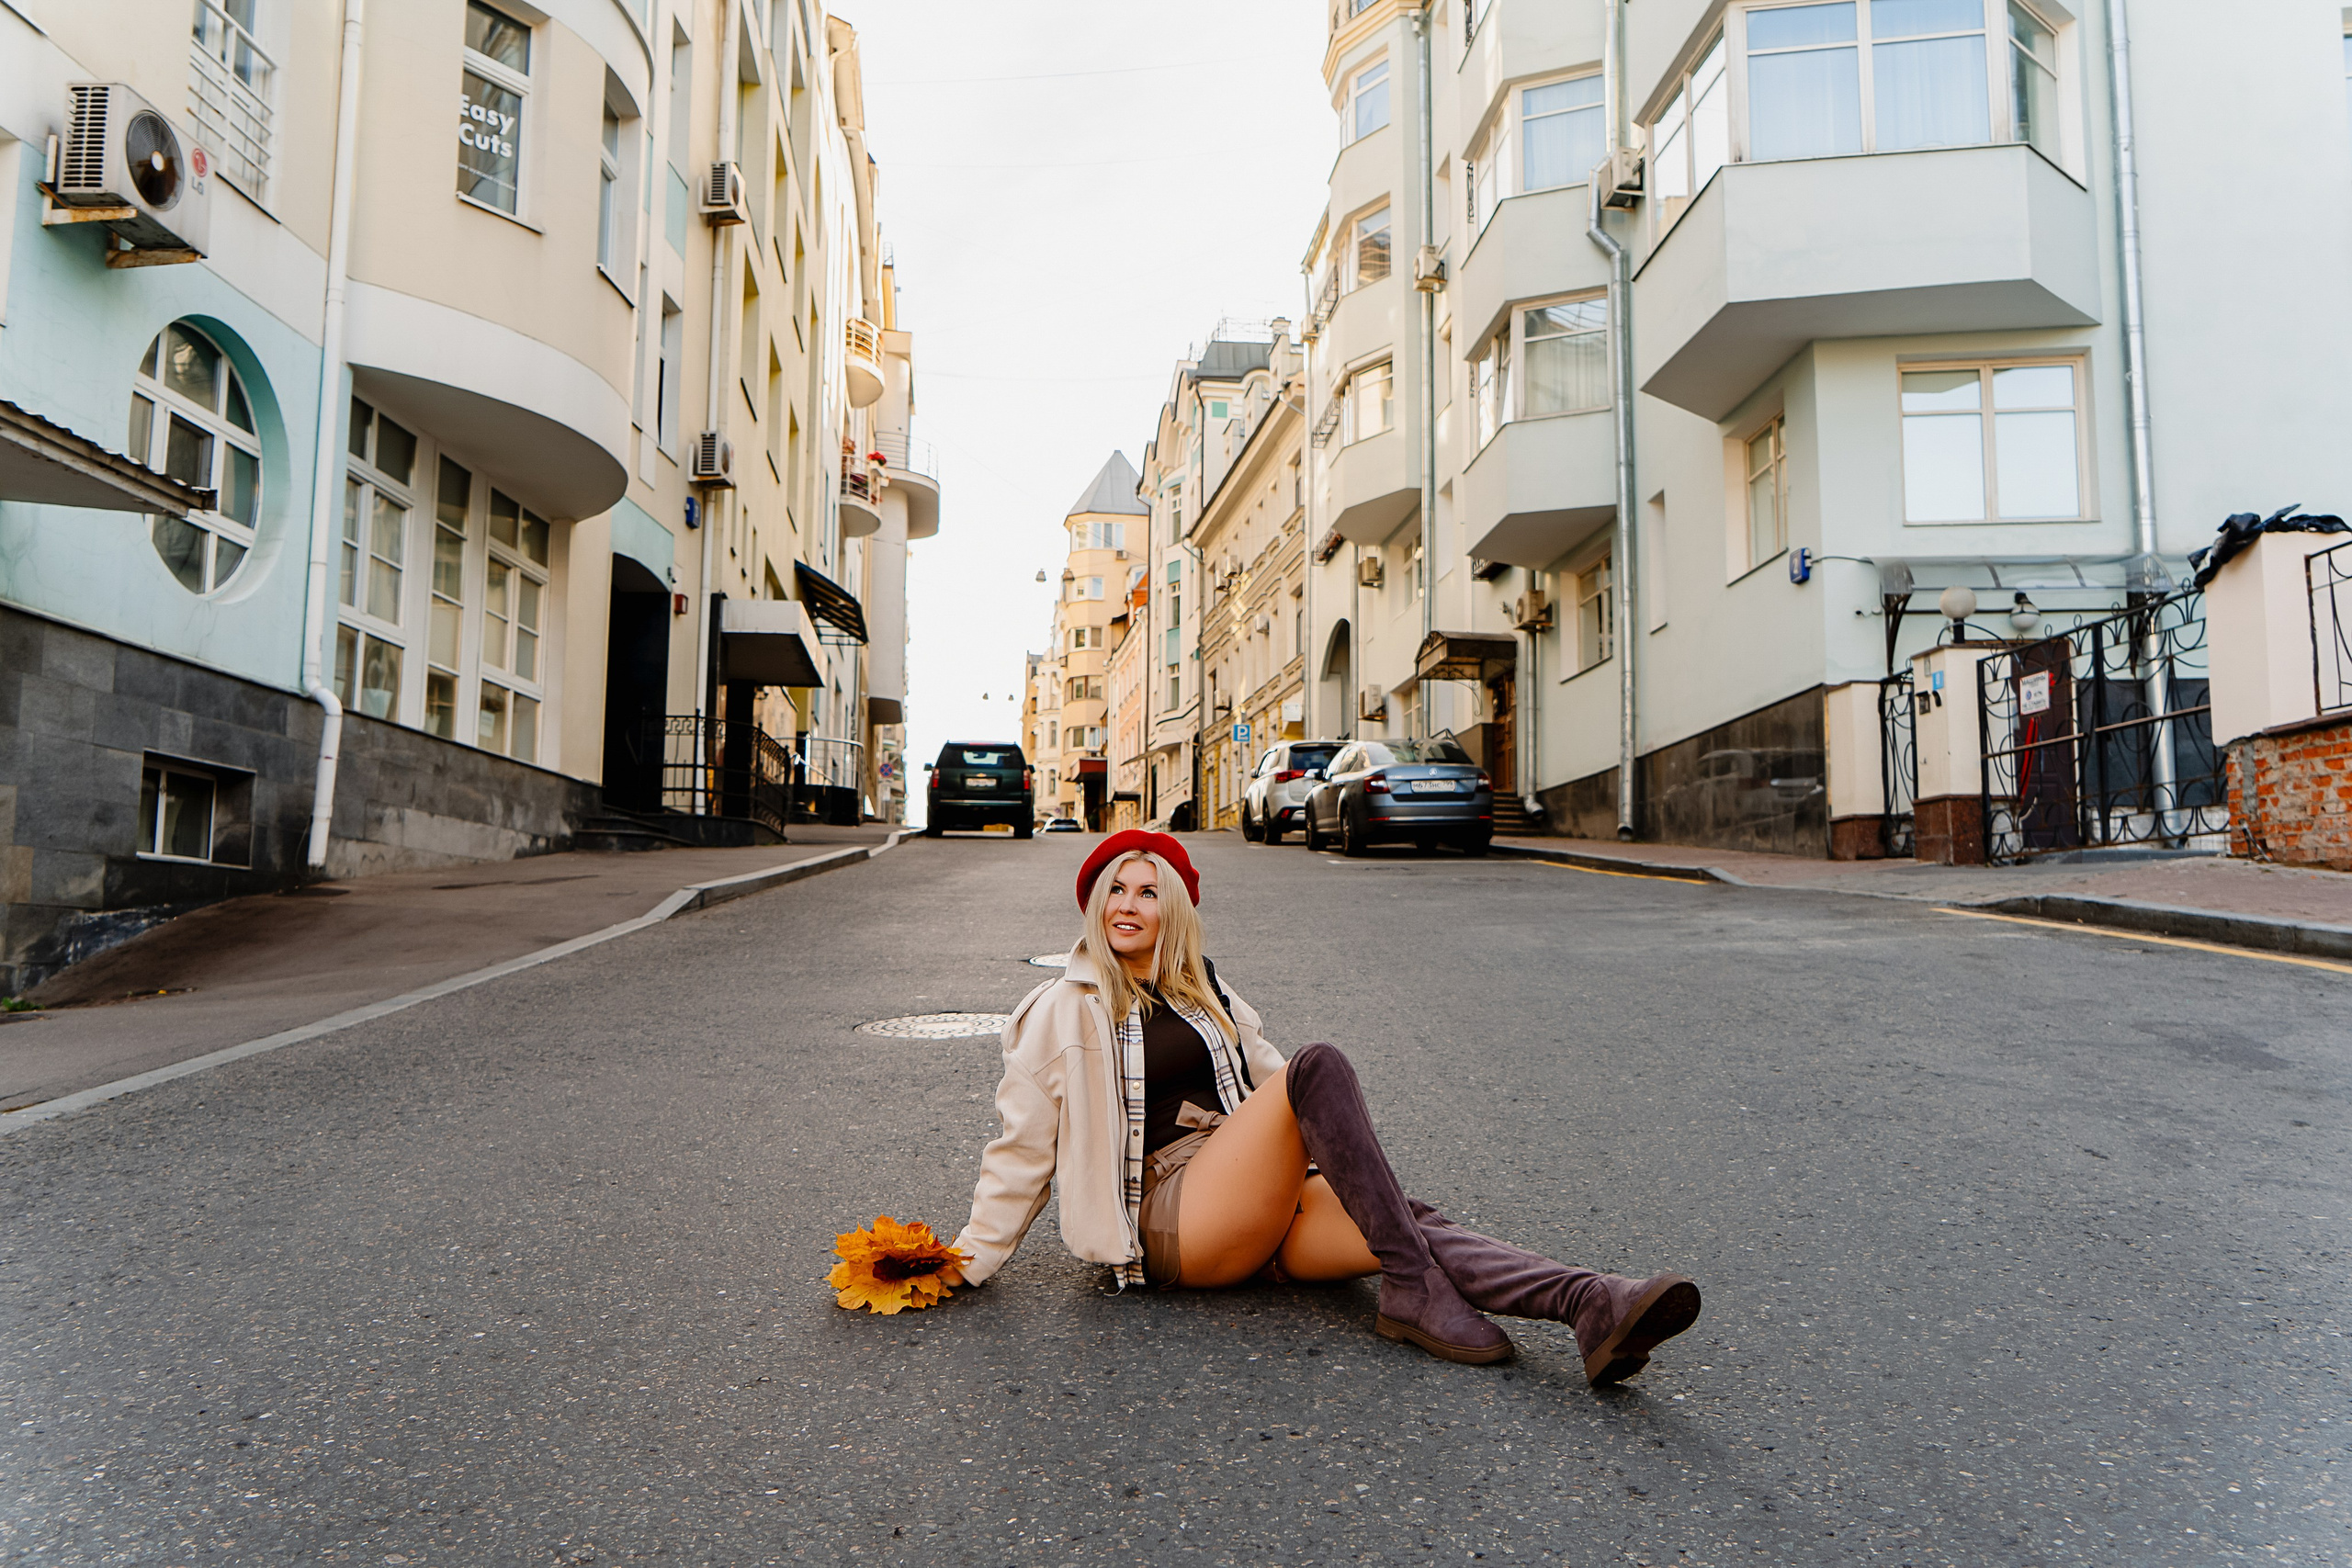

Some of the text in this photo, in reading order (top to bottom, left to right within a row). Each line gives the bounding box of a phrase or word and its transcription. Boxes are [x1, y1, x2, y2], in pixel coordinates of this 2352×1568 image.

[459, 94, 515, 135] Easy
[458, 122, 513, 158] Cuts
[191, 176, 204, 195] LG
[1237, 726, 1249, 740] P
